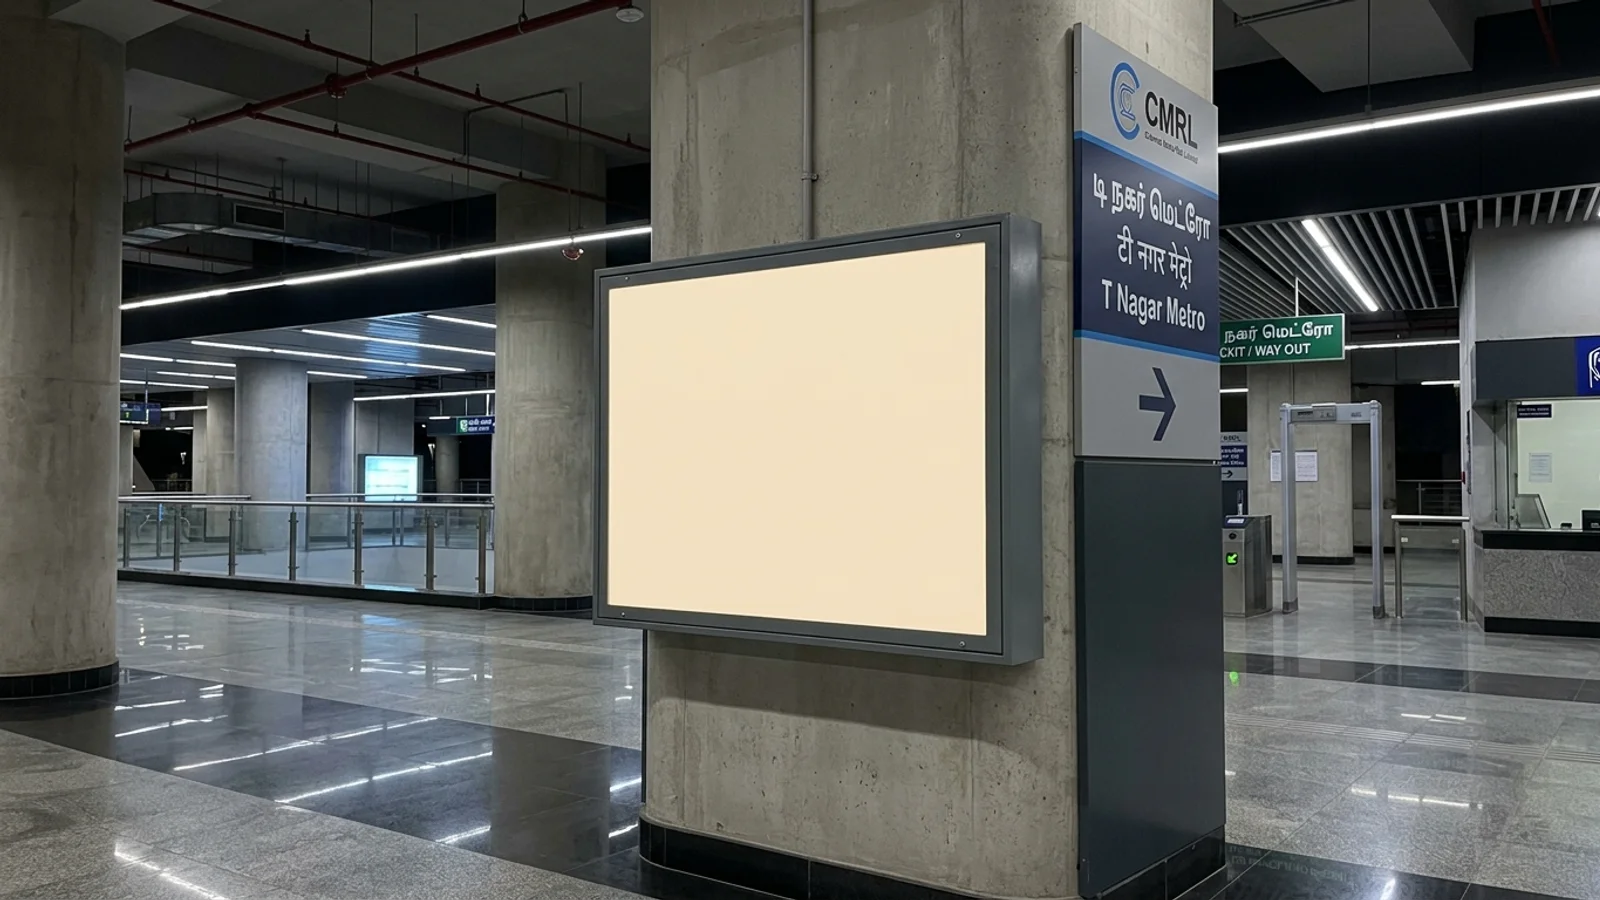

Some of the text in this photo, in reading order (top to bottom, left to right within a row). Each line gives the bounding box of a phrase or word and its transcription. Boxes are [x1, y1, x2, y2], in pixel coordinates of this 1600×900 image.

[1145, 91, 1198, 149] CMRL
[1093, 173, 1211, 241] டி நகர் மெட்ரோ
[1117, 225, 1193, 290] टी नगर मेट्रो
[1101, 279, 1206, 331] T Nagar Metro
[1255, 344, 1282, 357] WAY
[1284, 343, 1311, 355] OUT
